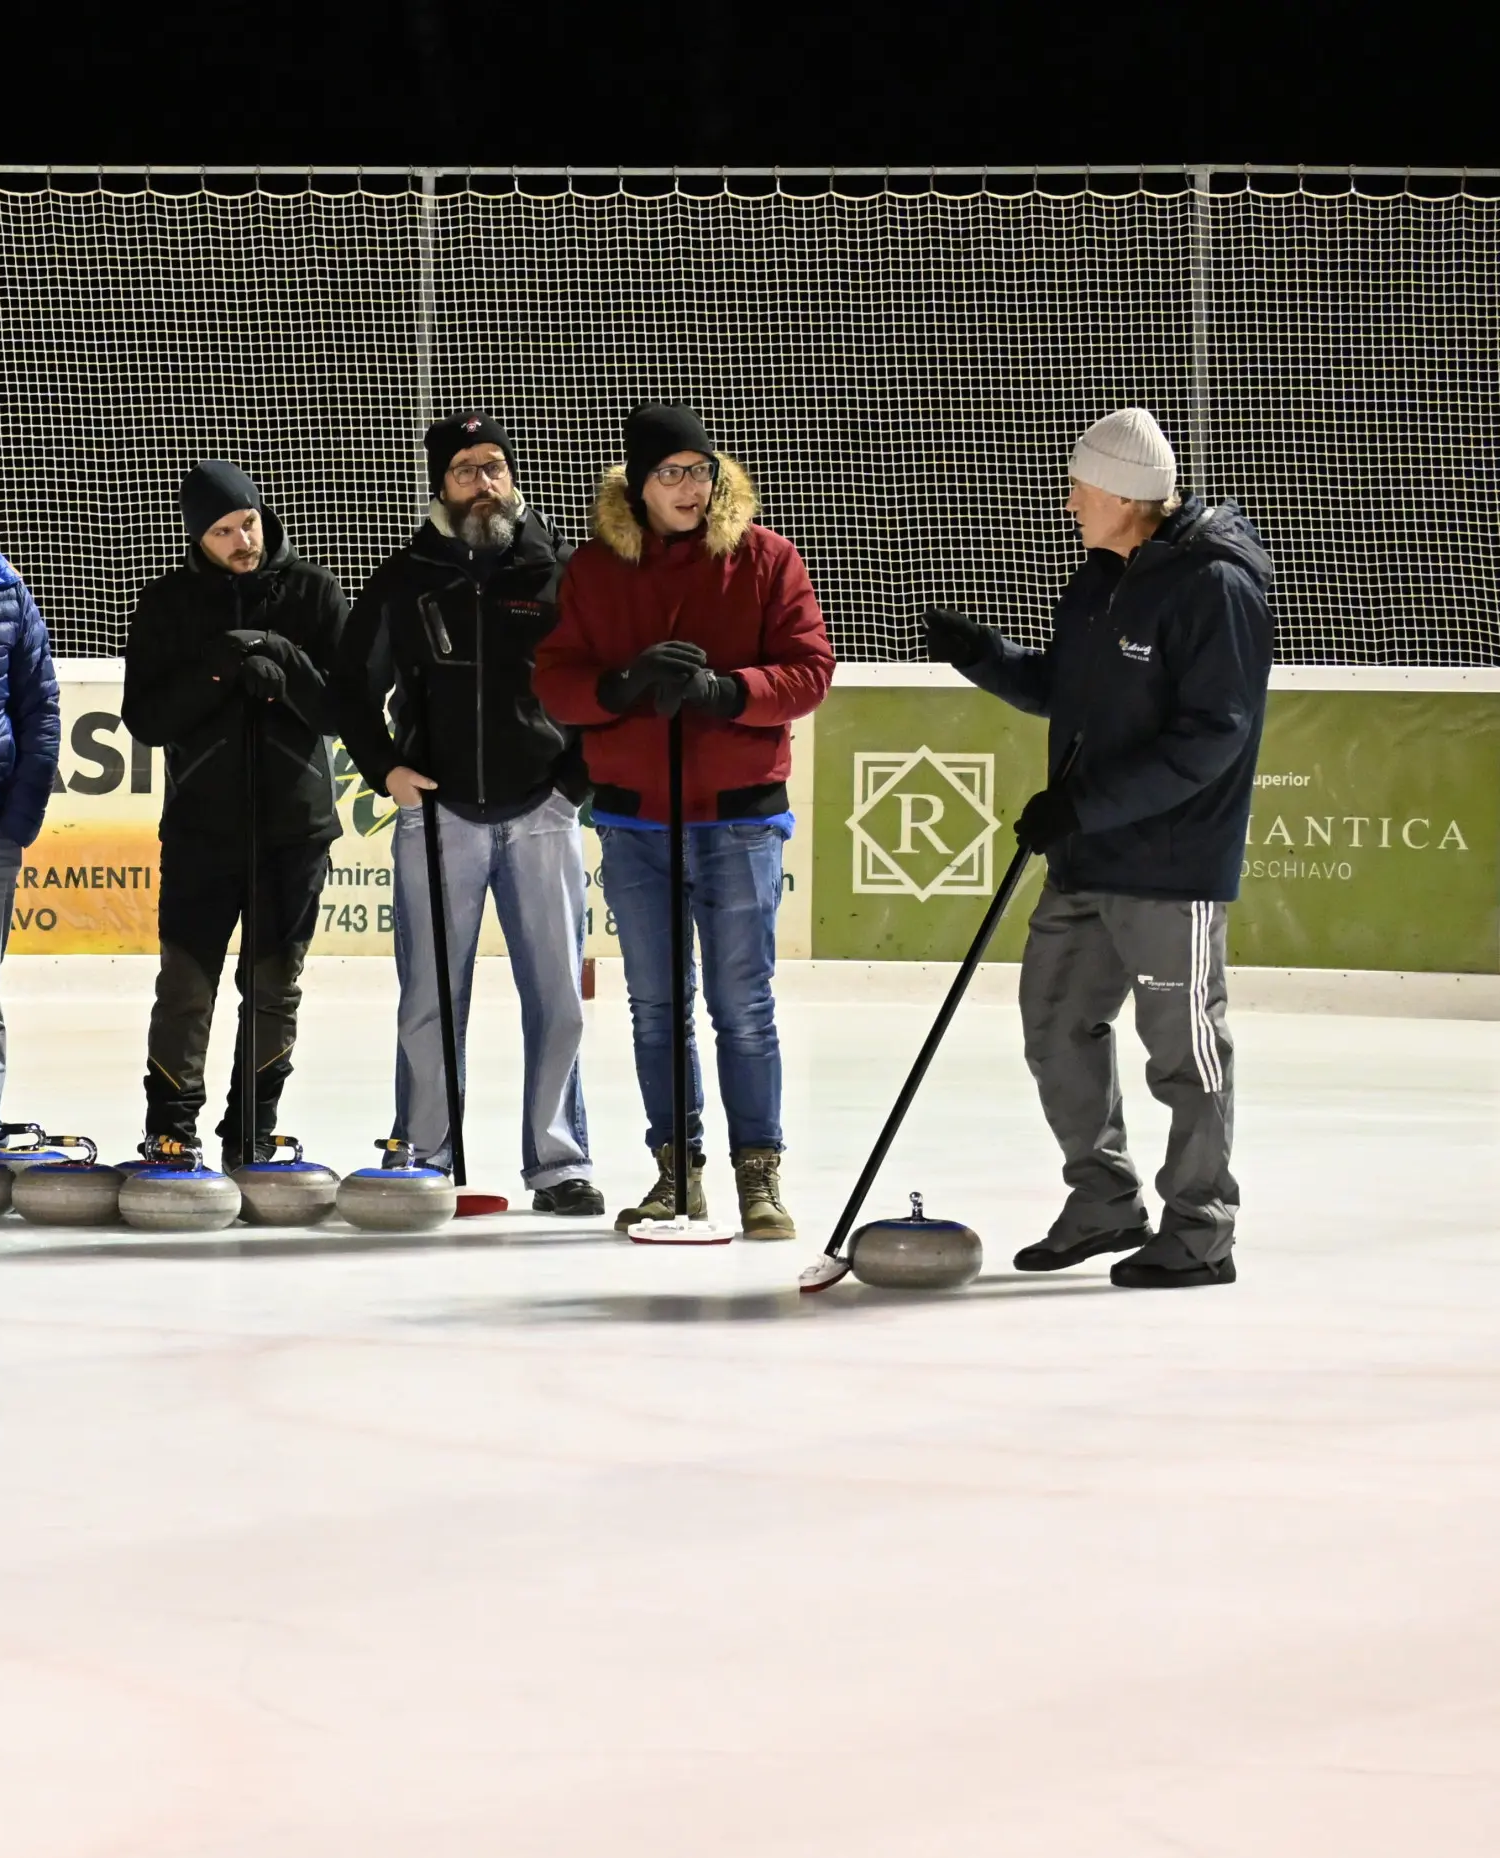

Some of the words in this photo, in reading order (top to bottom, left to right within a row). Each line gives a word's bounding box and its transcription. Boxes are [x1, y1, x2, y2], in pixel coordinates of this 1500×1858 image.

[51, 711, 152, 795] SI
[891, 793, 955, 855] R
[15, 866, 151, 889] RAMENTI
[10, 908, 58, 932] VO
